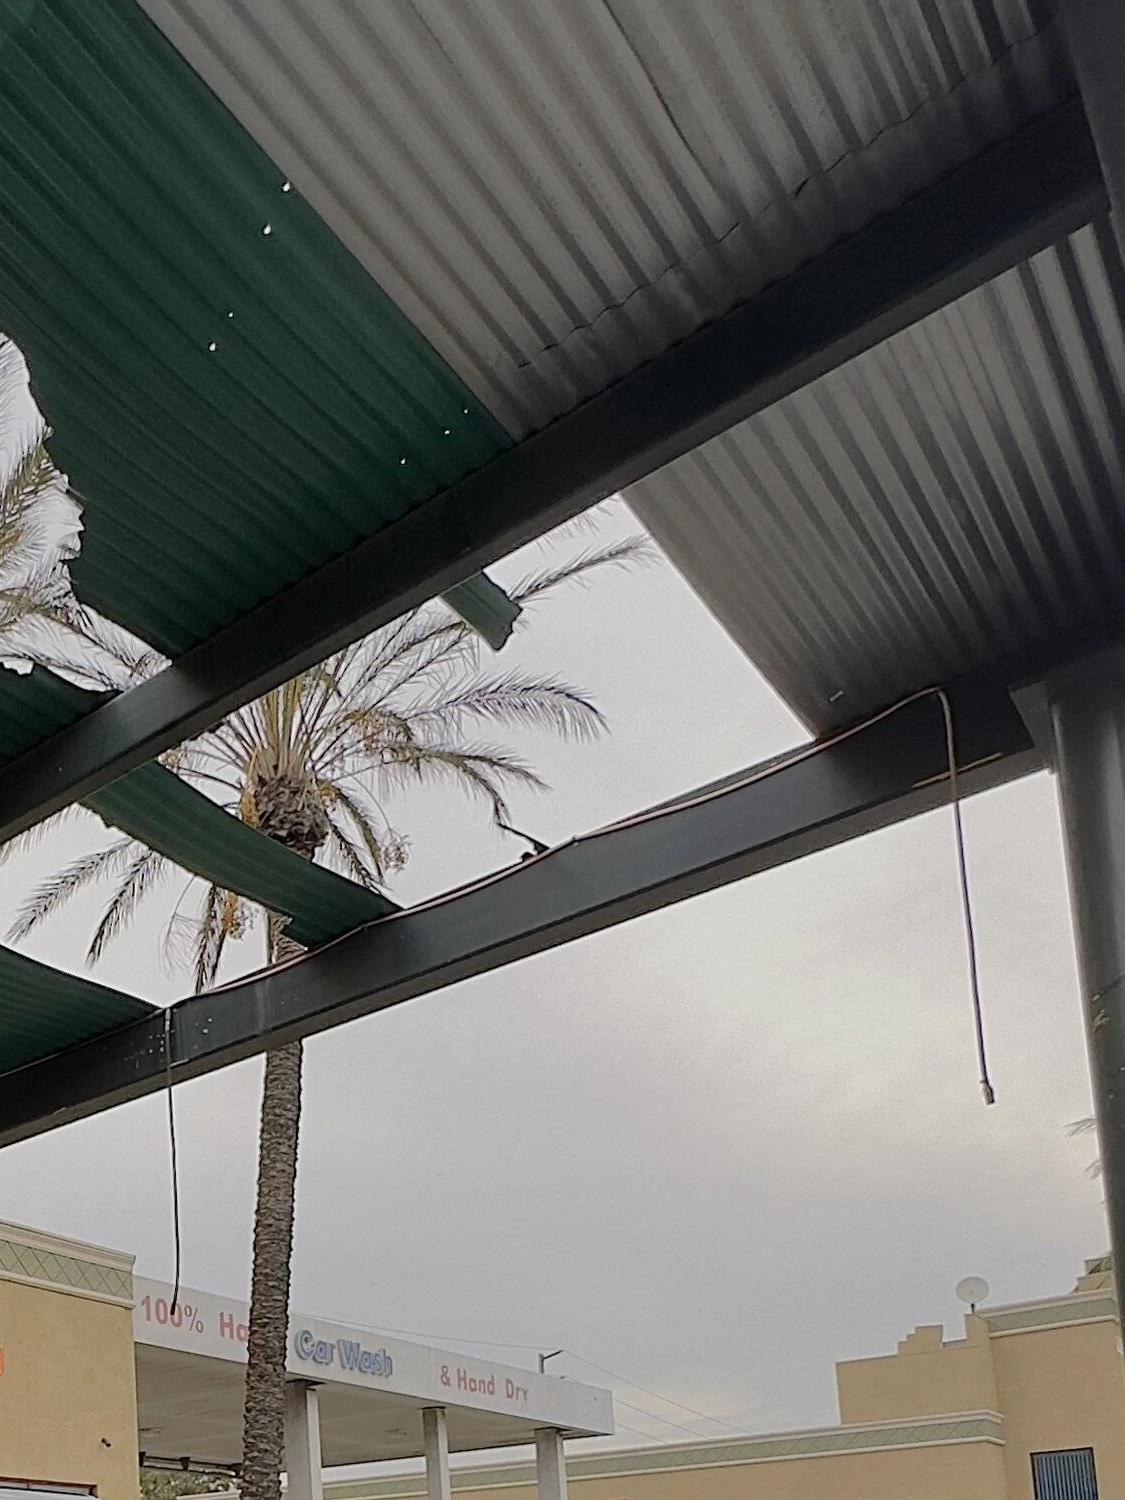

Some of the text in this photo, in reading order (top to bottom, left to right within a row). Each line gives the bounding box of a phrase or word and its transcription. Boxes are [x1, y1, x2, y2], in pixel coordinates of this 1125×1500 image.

[141, 1294, 530, 1402] 100% Ha Car Wash & Hand Dry
